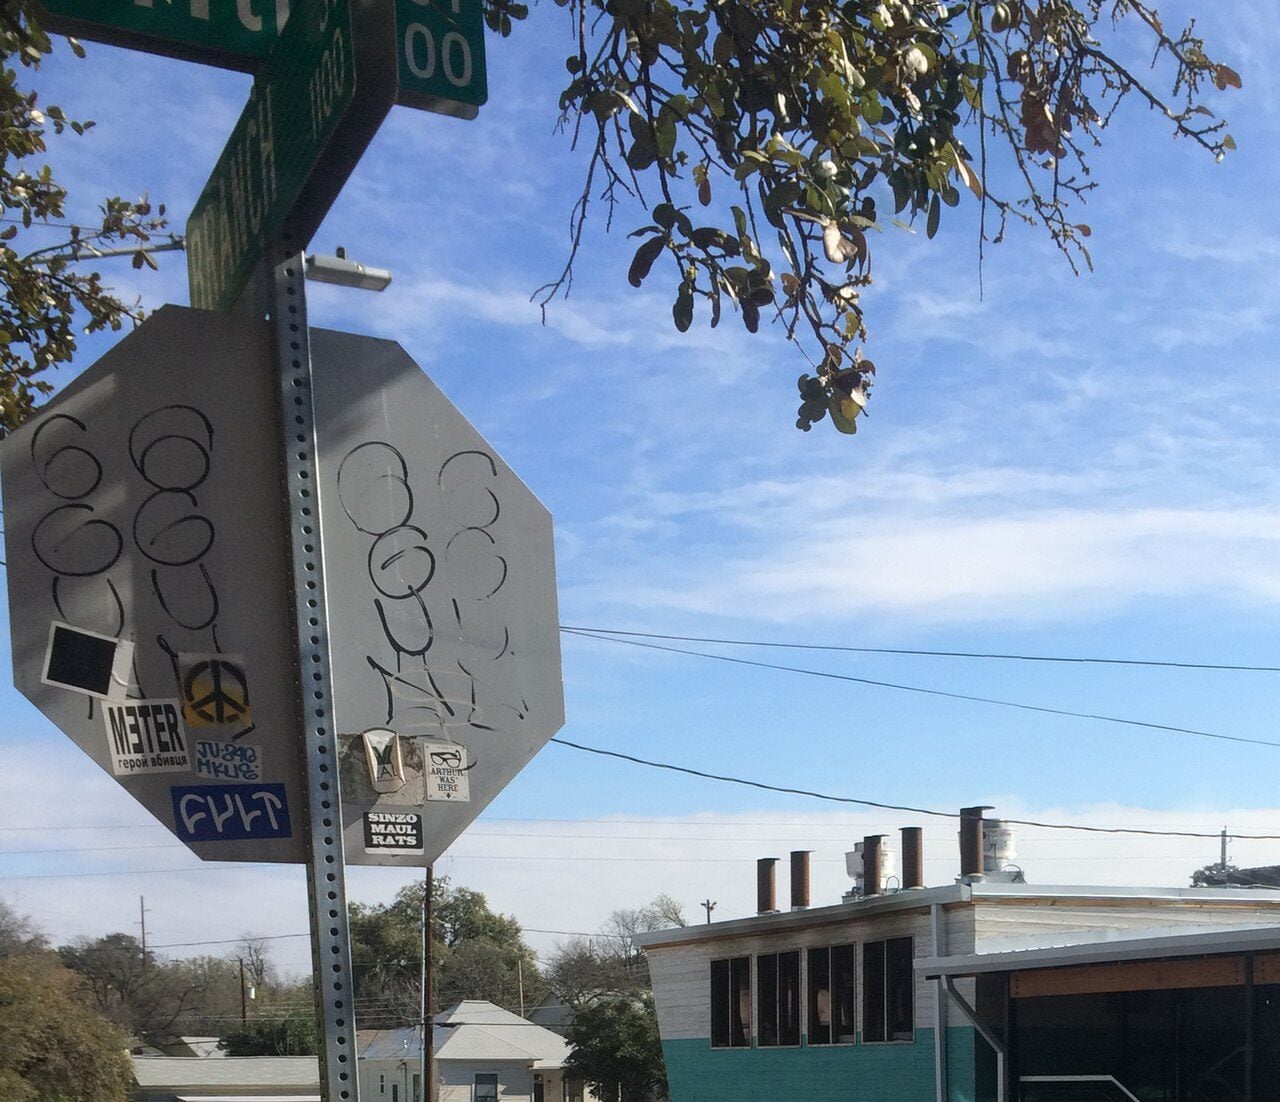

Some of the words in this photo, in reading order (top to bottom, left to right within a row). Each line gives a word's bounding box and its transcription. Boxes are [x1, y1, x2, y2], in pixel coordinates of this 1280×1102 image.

[190, 81, 277, 313] BRANCH
[118, 754, 149, 771] герой
[151, 753, 188, 768] вбивця
[430, 767, 465, 777] ARTHUR
[439, 776, 456, 784] WAS
[437, 783, 459, 792] HERE
[368, 812, 418, 824] SINZO
[370, 824, 417, 834] MAUL
[372, 835, 417, 846] RATS
